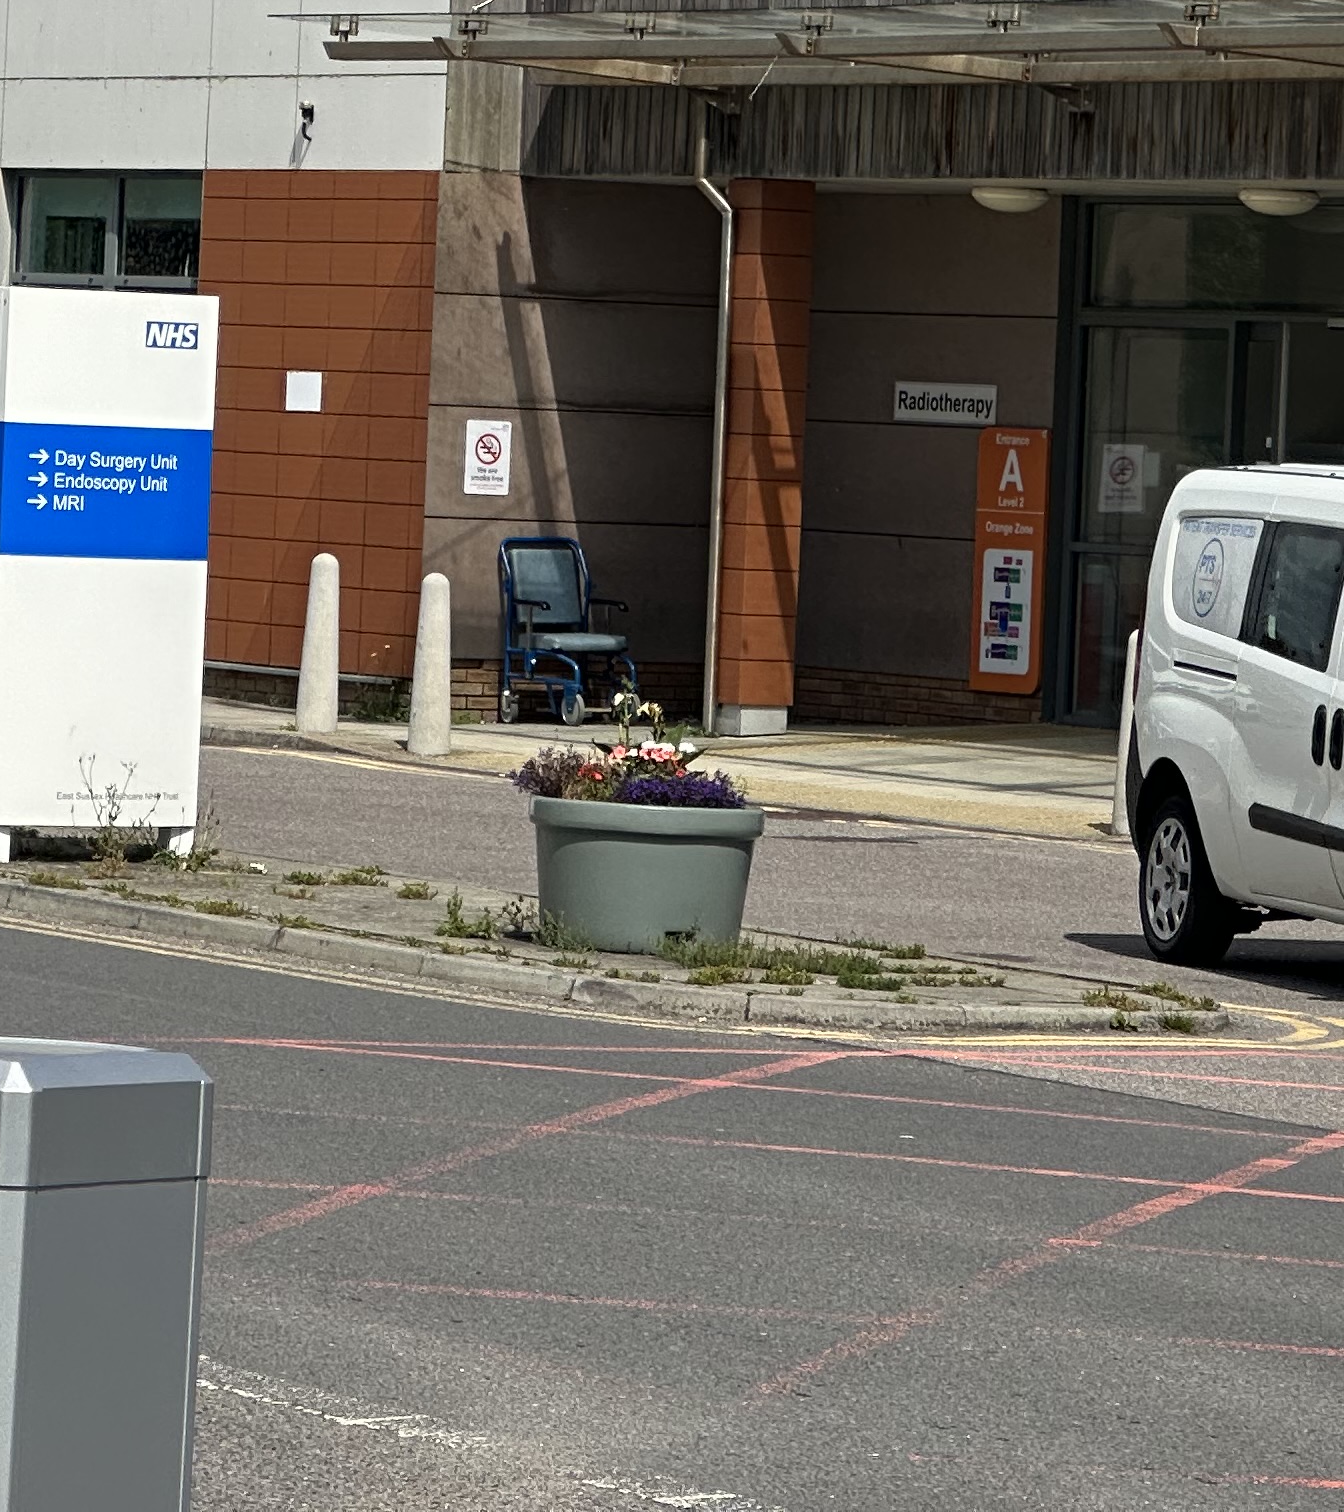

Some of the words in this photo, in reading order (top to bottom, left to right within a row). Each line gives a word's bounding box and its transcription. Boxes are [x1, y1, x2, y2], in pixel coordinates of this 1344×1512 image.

[147, 322, 198, 348] NHS
[898, 390, 994, 419] Radiotherapy
[995, 433, 1030, 446] Entrance
[54, 450, 86, 470] Day
[89, 451, 147, 472] Surgery
[150, 454, 178, 470] Unit
[998, 448, 1024, 493] A
[54, 472, 137, 494] Endoscopy
[140, 475, 168, 492] Unit
[53, 494, 85, 511] MRI
[998, 496, 1018, 508] Level
[1019, 497, 1025, 509] 2
[985, 521, 1013, 536] Orange
[1014, 523, 1034, 535] Zone
[56, 791, 74, 800] East
